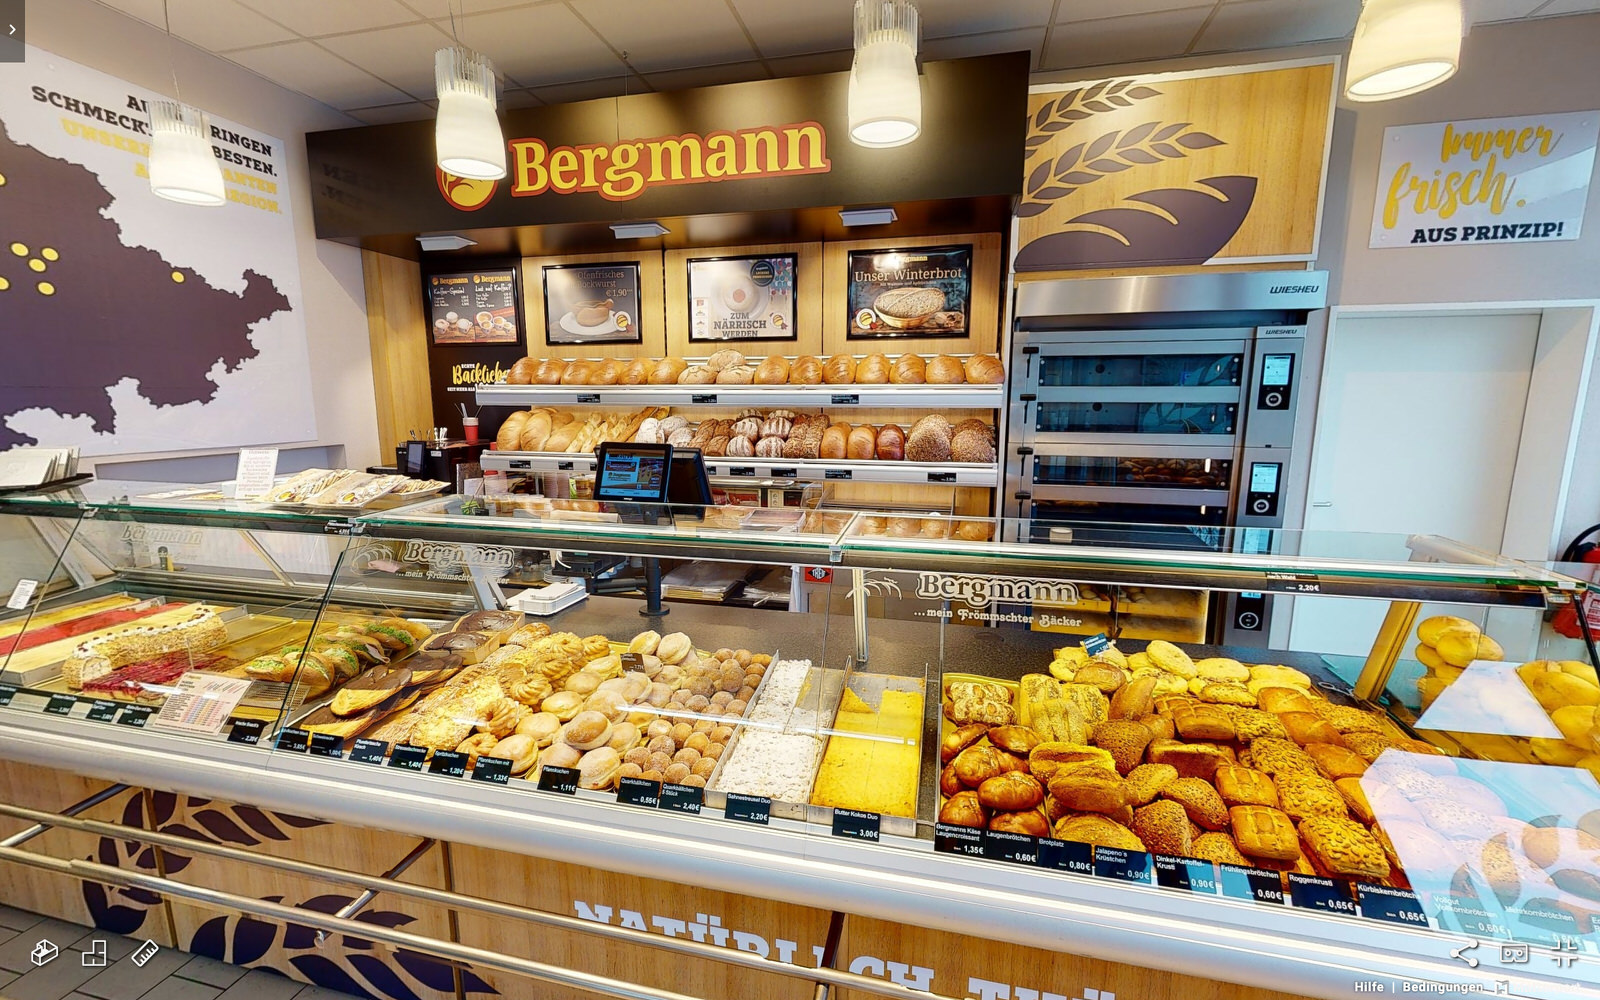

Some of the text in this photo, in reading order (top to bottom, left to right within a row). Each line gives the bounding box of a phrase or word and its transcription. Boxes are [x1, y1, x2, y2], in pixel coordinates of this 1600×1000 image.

[31, 86, 278, 177] SCHMECK BESTEN.
[210, 125, 272, 157] RINGEN
[1441, 123, 1563, 162] Immer
[511, 123, 829, 200] Bergmann
[1383, 153, 1526, 229] frisch.
[1411, 222, 1564, 244] AUS PRINZIP!
[855, 267, 962, 282] Unser Winterbrot
[1270, 286, 1319, 294] WIESHEU
[714, 318, 767, 330] NÄRRISCH
[722, 330, 758, 338] WERDEN
[405, 539, 513, 569] Bergmann
[917, 573, 1079, 607] Bergmann
[1298, 584, 1320, 592] 2,20€
[957, 608, 1034, 625] Frömmschter
[1038, 615, 1082, 628] Bäcker
[543, 766, 570, 775] Pfannkuchen
[493, 774, 508, 782] 1,33€
[621, 778, 652, 787] Quarkbällchen
[560, 784, 576, 792] 1,11€
[662, 783, 694, 793] Quarkbällchen
[728, 793, 760, 803] Sahnestreusel
[750, 812, 768, 821] 2,20€
[850, 811, 867, 819] Kokos
[859, 829, 879, 838] 3,00€
[936, 823, 966, 834] Bergmanns
[936, 830, 980, 841] Laugencroissant
[986, 830, 1031, 843] Laugenbrötchen
[1039, 838, 1064, 848] Brotplatz
[963, 844, 984, 855] 1,35€
[1015, 853, 1037, 862] 0,60€
[1095, 854, 1126, 864] Krüstchen
[1155, 855, 1205, 868] Dinkel-Kartoffel-
[1069, 860, 1091, 871] 0,80€
[1127, 870, 1150, 880] 0,90€
[1221, 864, 1279, 879] Frühlingsbrötchen
[1191, 878, 1214, 889] 0,90€
[1289, 874, 1333, 887] Roggenkrusti
[1257, 888, 1282, 900] 0,60€
[1328, 899, 1354, 911] 0,65€
[1399, 910, 1426, 923] 0,65€
